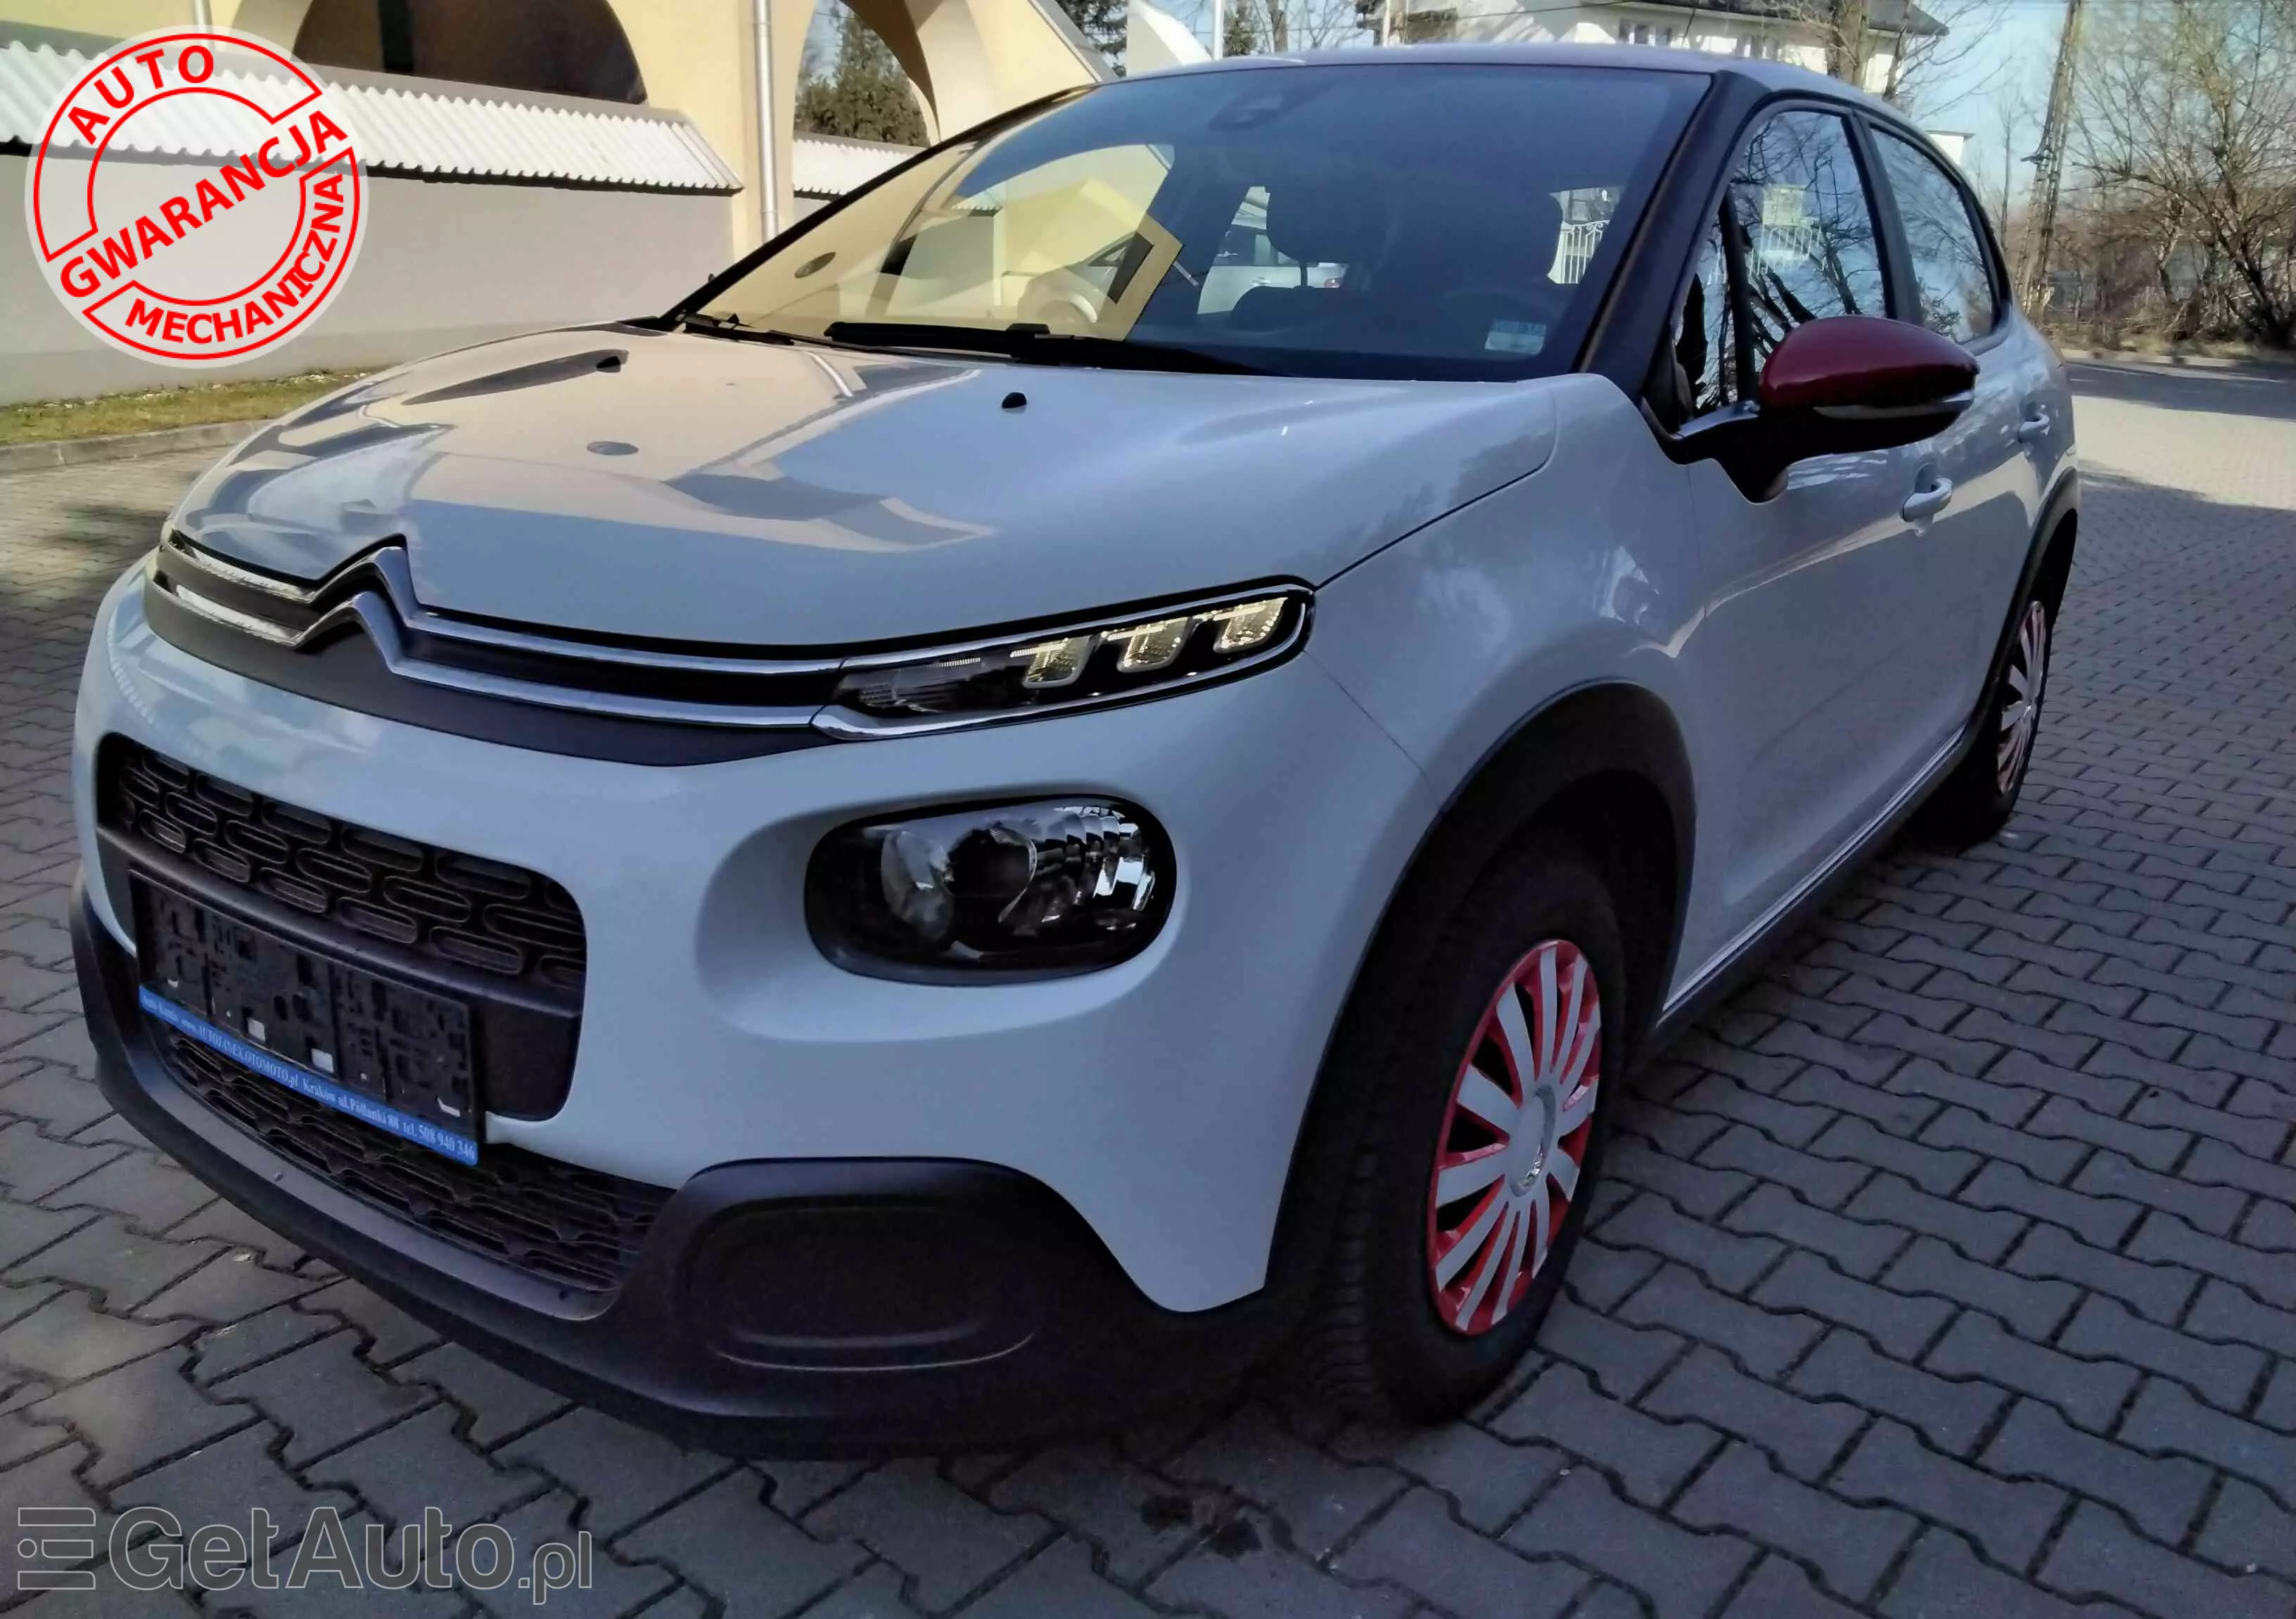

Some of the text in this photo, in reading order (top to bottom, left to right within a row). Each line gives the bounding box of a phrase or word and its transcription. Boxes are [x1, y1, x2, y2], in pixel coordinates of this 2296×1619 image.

[418, 1125, 436, 1144] 508
[438, 1131, 456, 1152] 940
[456, 1139, 476, 1160] 346
